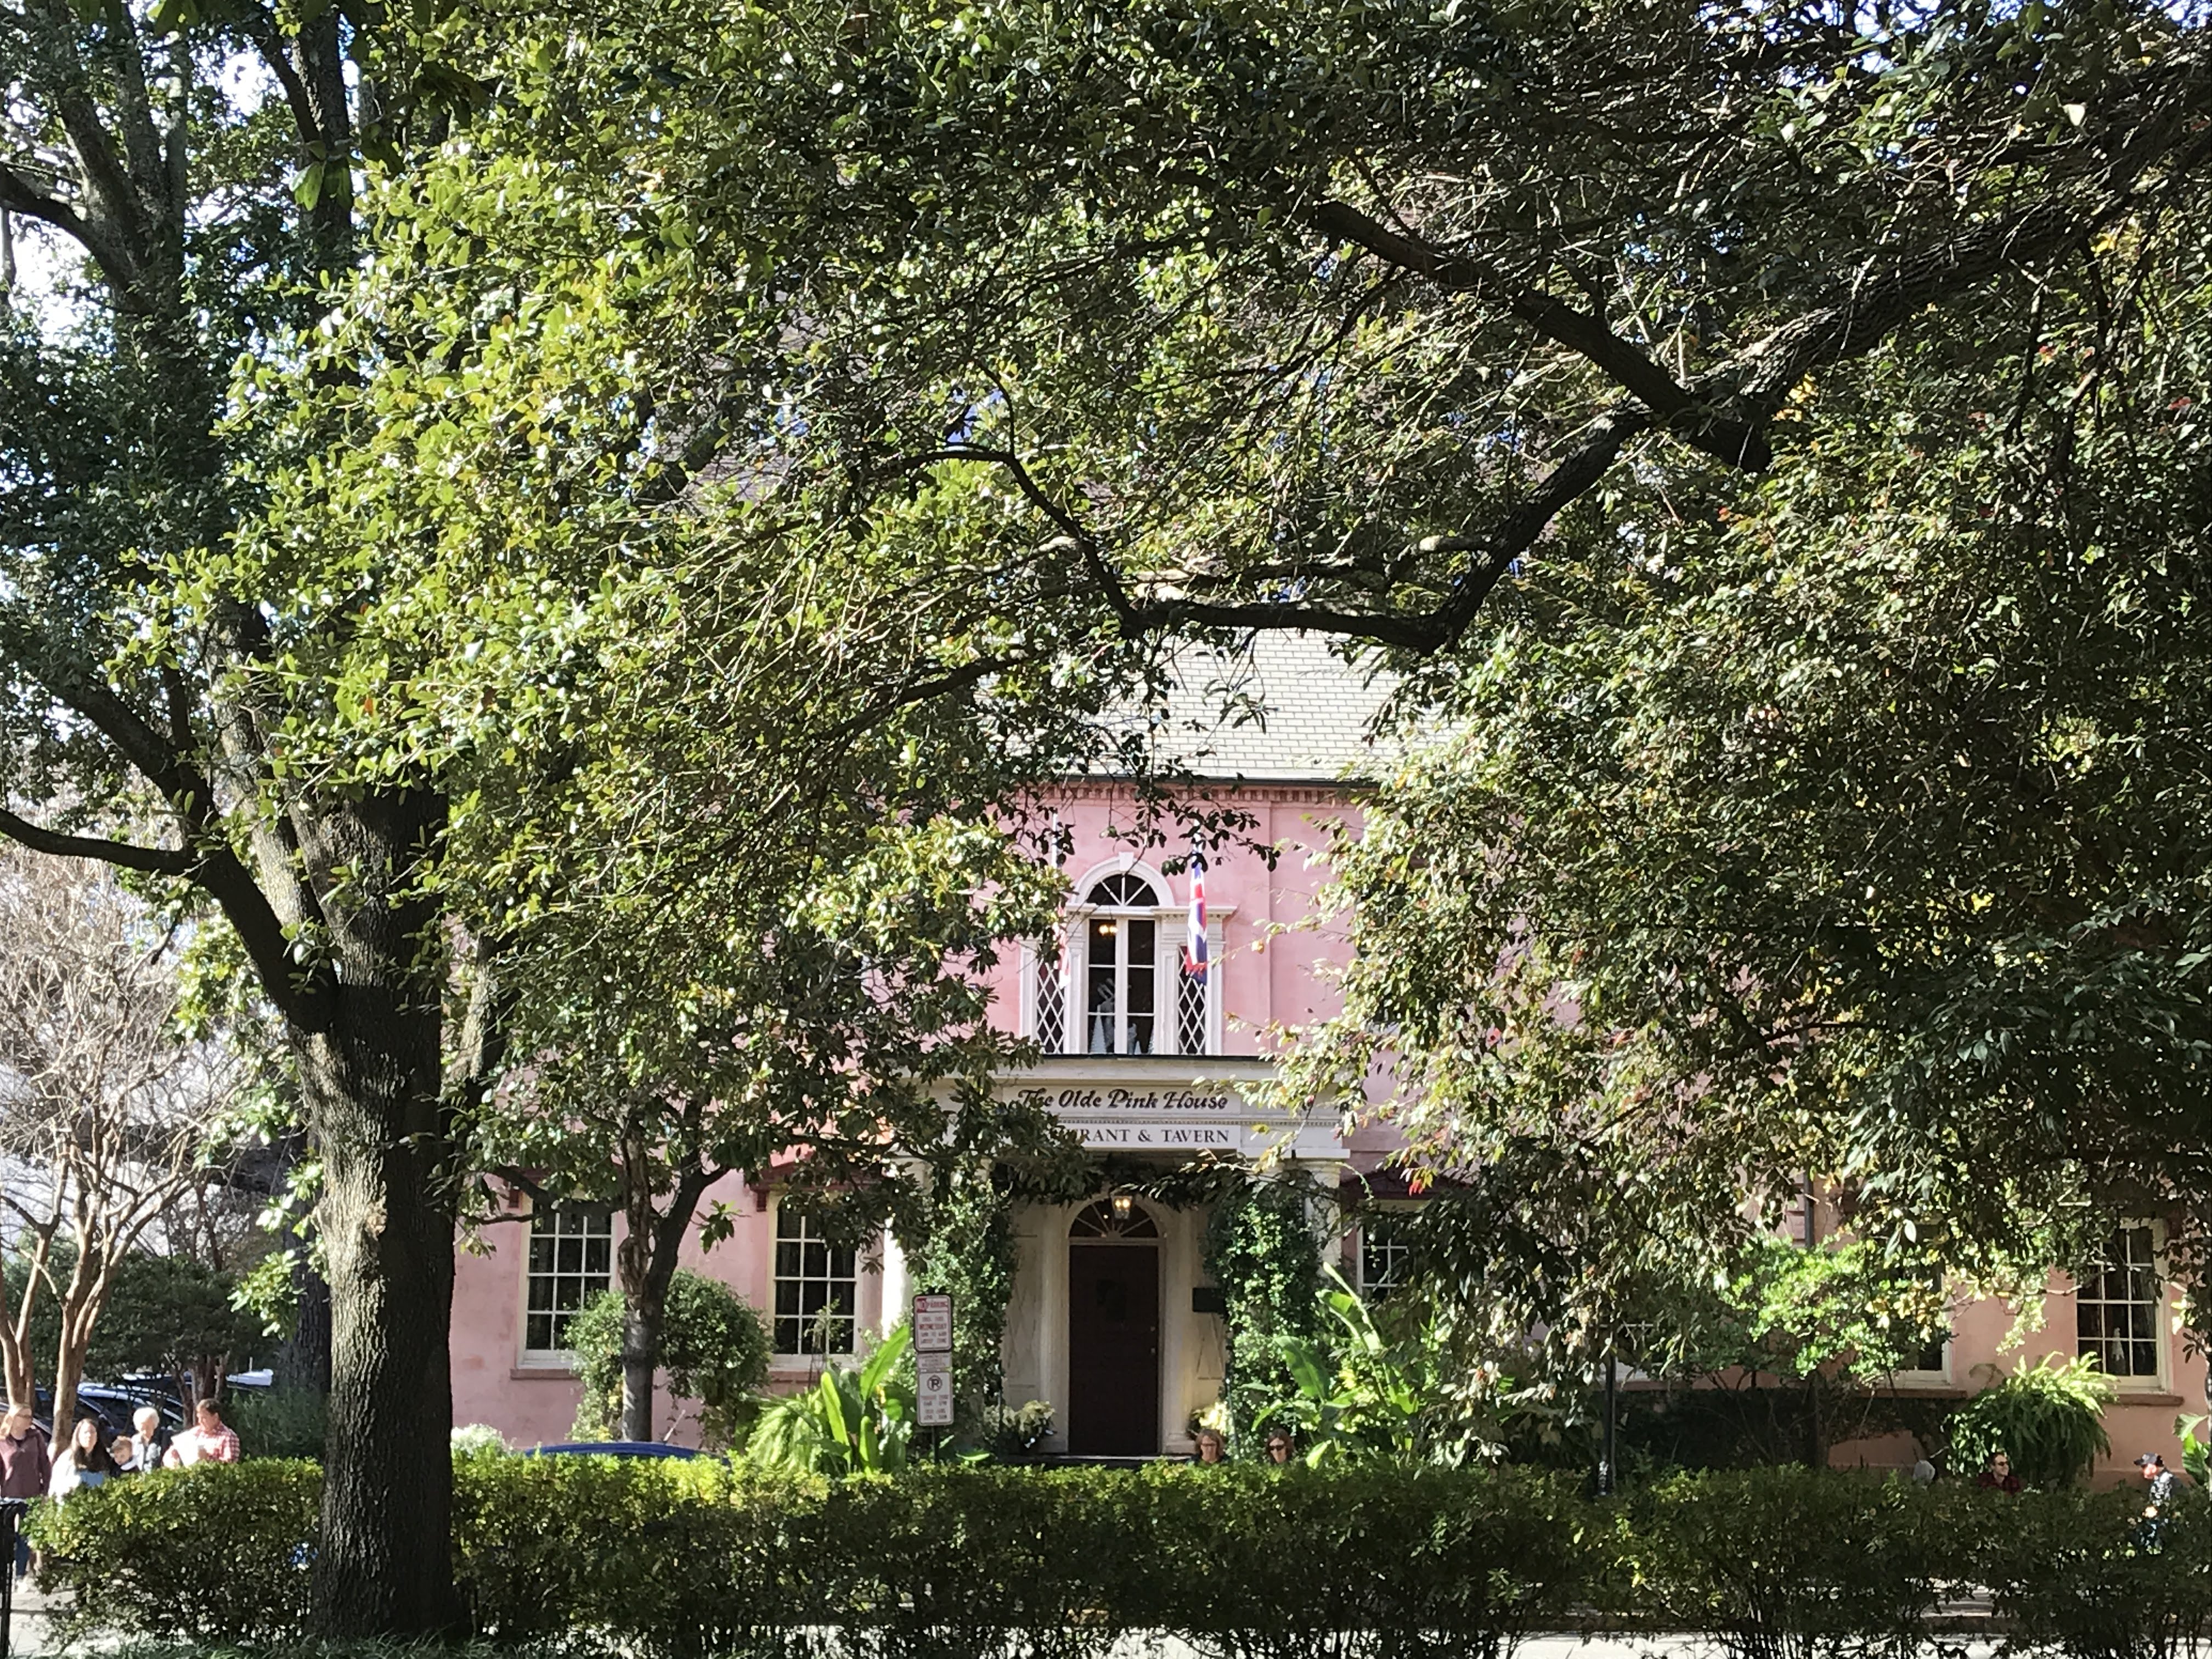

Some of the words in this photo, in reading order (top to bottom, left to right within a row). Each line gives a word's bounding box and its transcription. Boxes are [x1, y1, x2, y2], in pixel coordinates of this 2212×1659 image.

[1059, 1090, 1102, 1108] Olde
[1108, 1088, 1159, 1109] Pink
[1163, 1091, 1228, 1109] House
[1138, 1129, 1153, 1142] &
[1161, 1129, 1229, 1143] TAVERN
